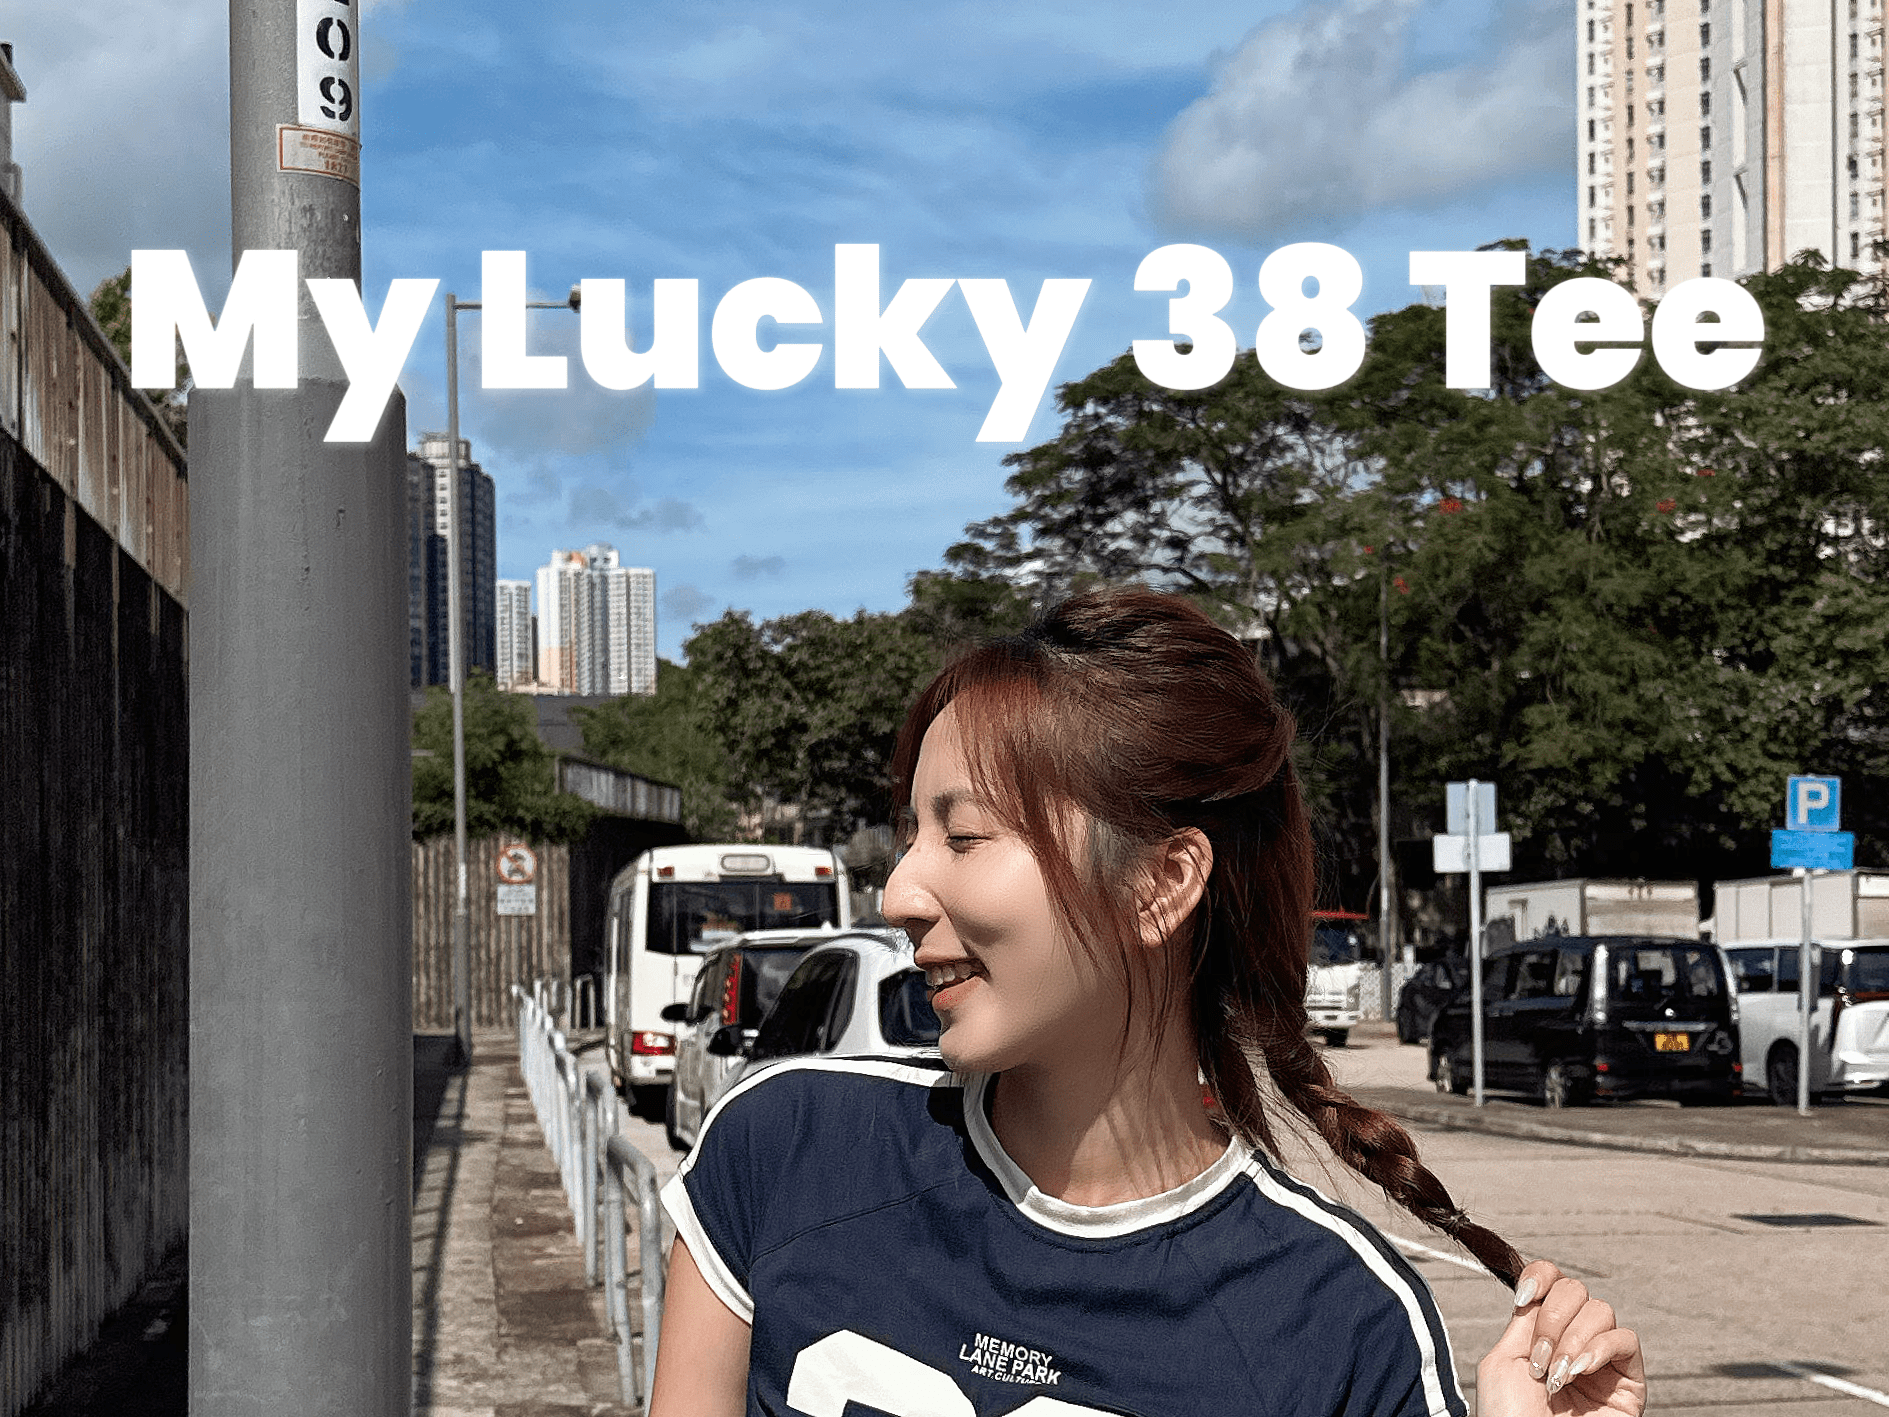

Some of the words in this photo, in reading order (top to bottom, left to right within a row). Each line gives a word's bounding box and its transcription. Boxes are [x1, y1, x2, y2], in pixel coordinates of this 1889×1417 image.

[315, 0, 353, 122] 09
[1798, 783, 1829, 824] P
[959, 1343, 1009, 1373] LANE
[1011, 1359, 1062, 1386] PARK
[974, 1332, 1053, 1367] MEMORY
